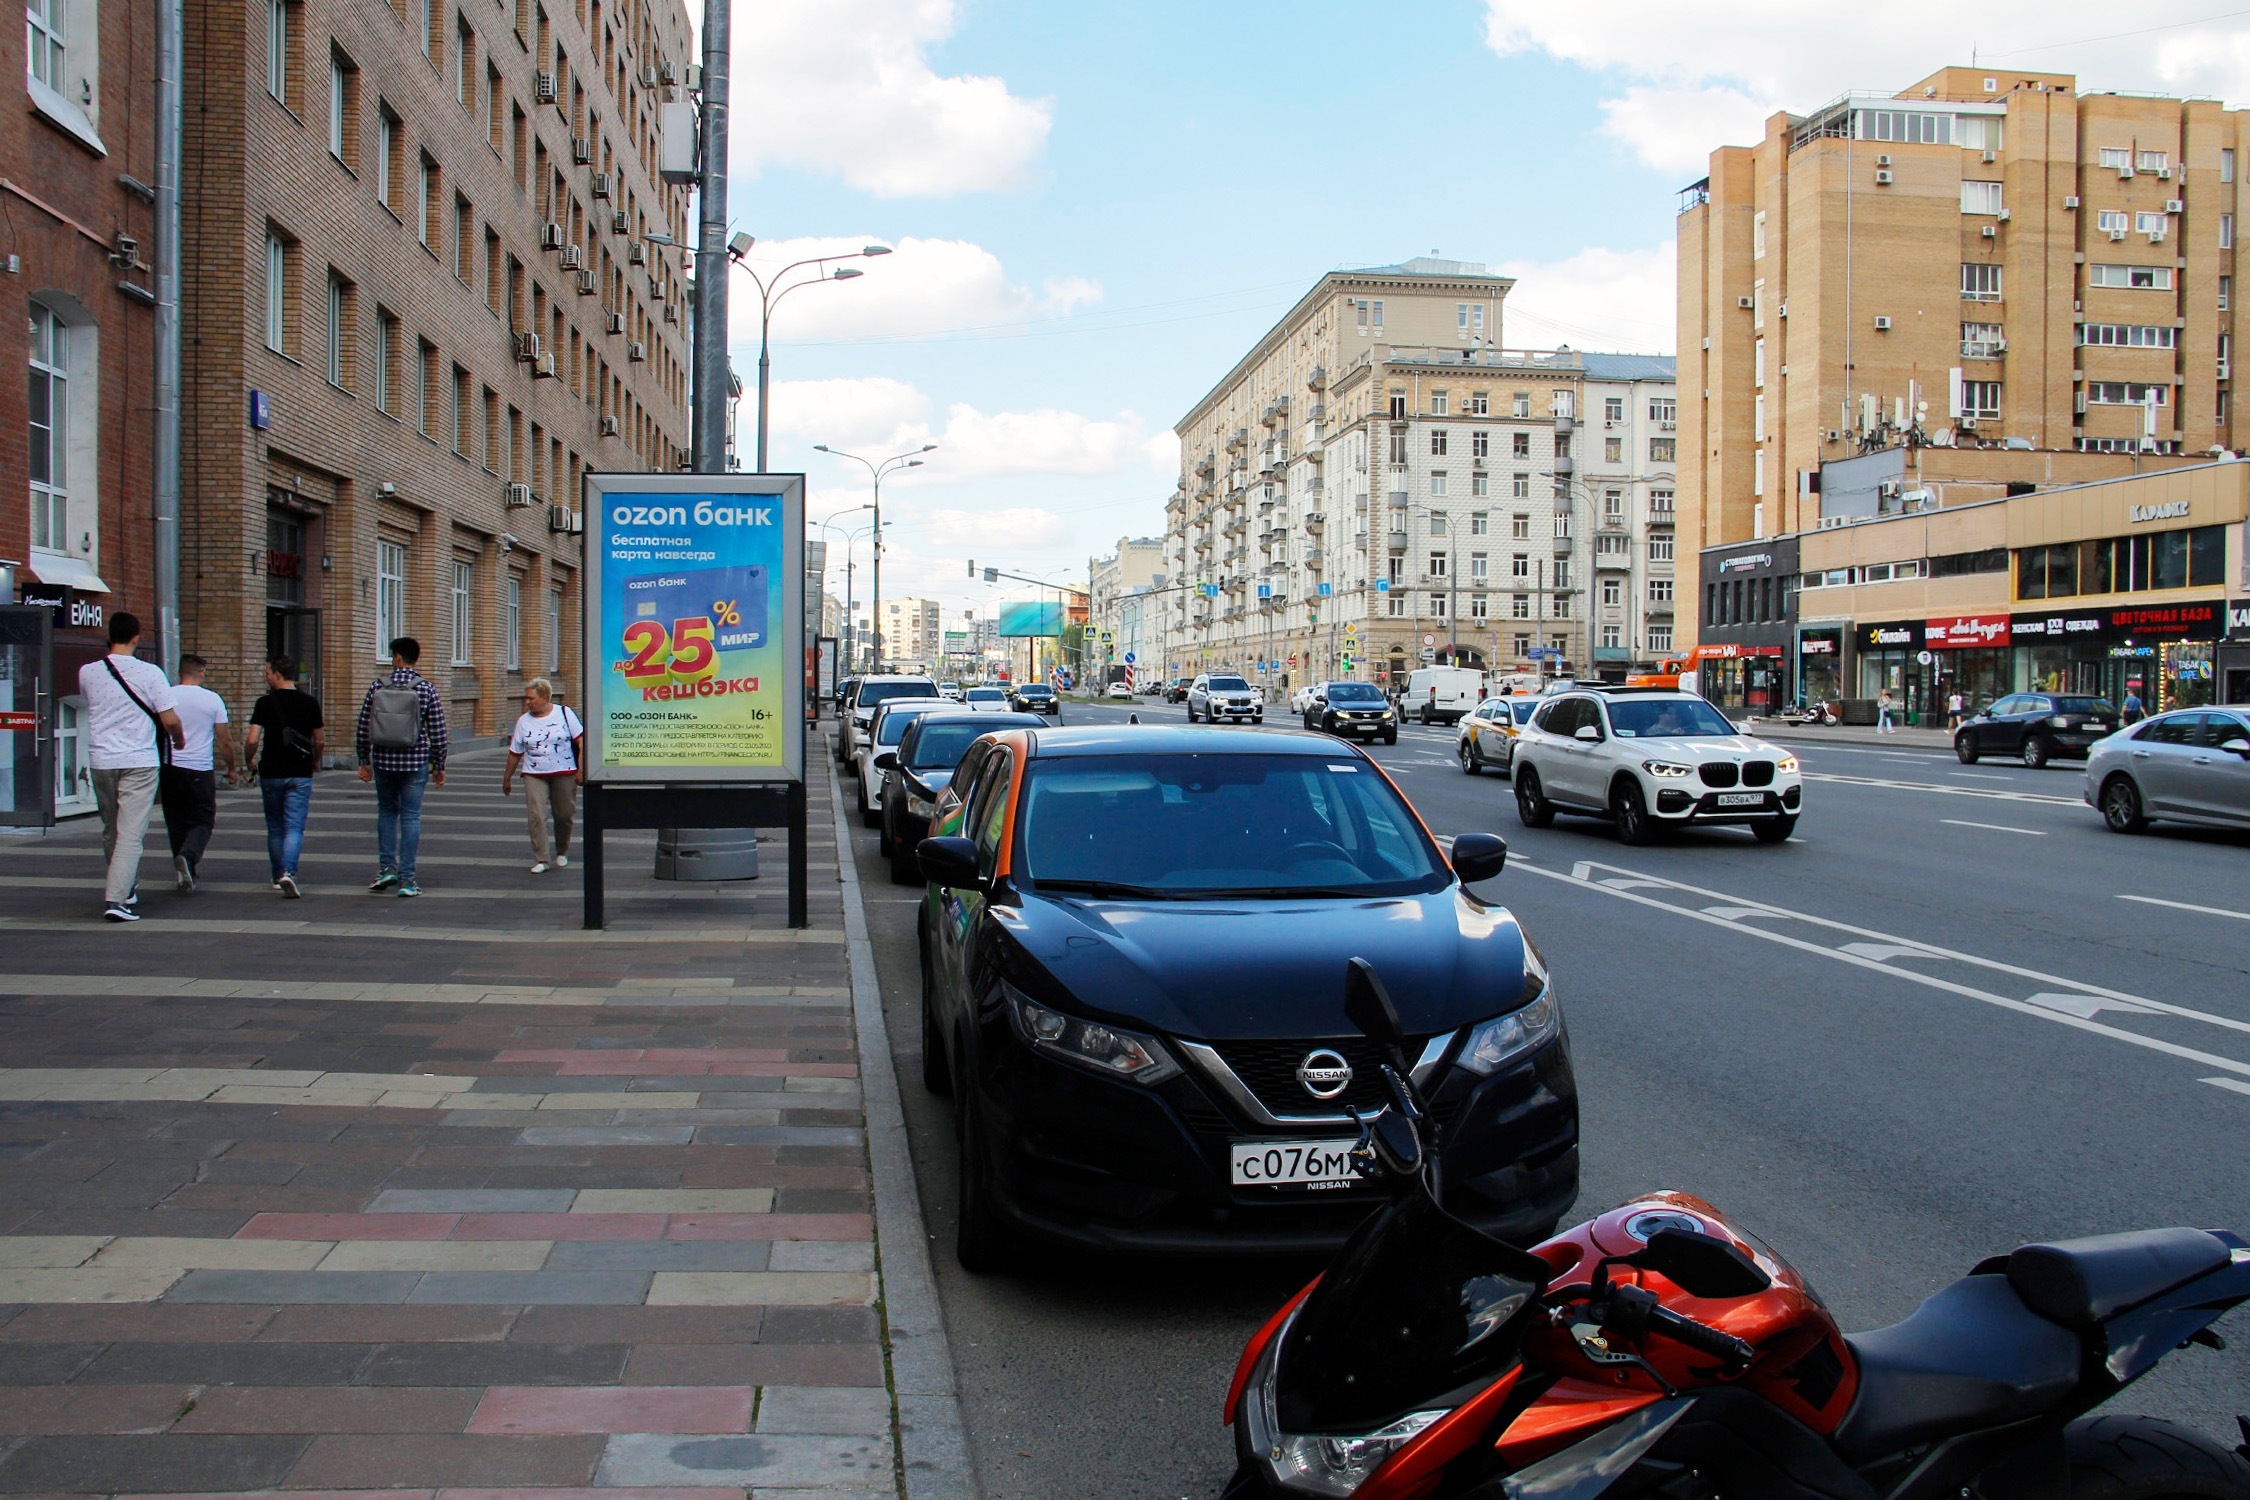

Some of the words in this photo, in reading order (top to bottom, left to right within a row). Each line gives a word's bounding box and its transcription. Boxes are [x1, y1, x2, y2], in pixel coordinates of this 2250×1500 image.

[612, 506, 687, 525] ozon
[693, 501, 773, 526] банк
[611, 534, 692, 546] бесплатная
[611, 551, 651, 561] карта
[655, 551, 716, 561] навсегда
[629, 580, 657, 590] ozon
[658, 577, 687, 588] банк
[2112, 609, 2178, 626] ЦВЕТОЧНАЯ
[2181, 607, 2212, 621] БАЗА
[2229, 608, 2250, 628] КА
[2011, 622, 2045, 634] ЖЕНСКАЯ
[2065, 619, 2099, 632] ОДЕЖДА
[721, 632, 760, 646] МИР
[1878, 628, 1911, 644] билайн
[2113, 648, 2133, 657] ТАБАК
[2135, 647, 2151, 656] VAPE
[613, 660, 635, 672] до
[2178, 660, 2199, 670] ТАБАК
[2179, 670, 2198, 680] VAPE
[642, 675, 760, 702] кешбэка
[610, 712, 633, 720] ООО
[634, 712, 666, 720] «ОЗОН
[667, 712, 698, 720] БАНК»
[751, 708, 773, 720] 16+
[7, 717, 43, 726] ЗАВТРАК
[1302, 1070, 1348, 1079] NISSAN
[1306, 1180, 1350, 1190] NISSAN
